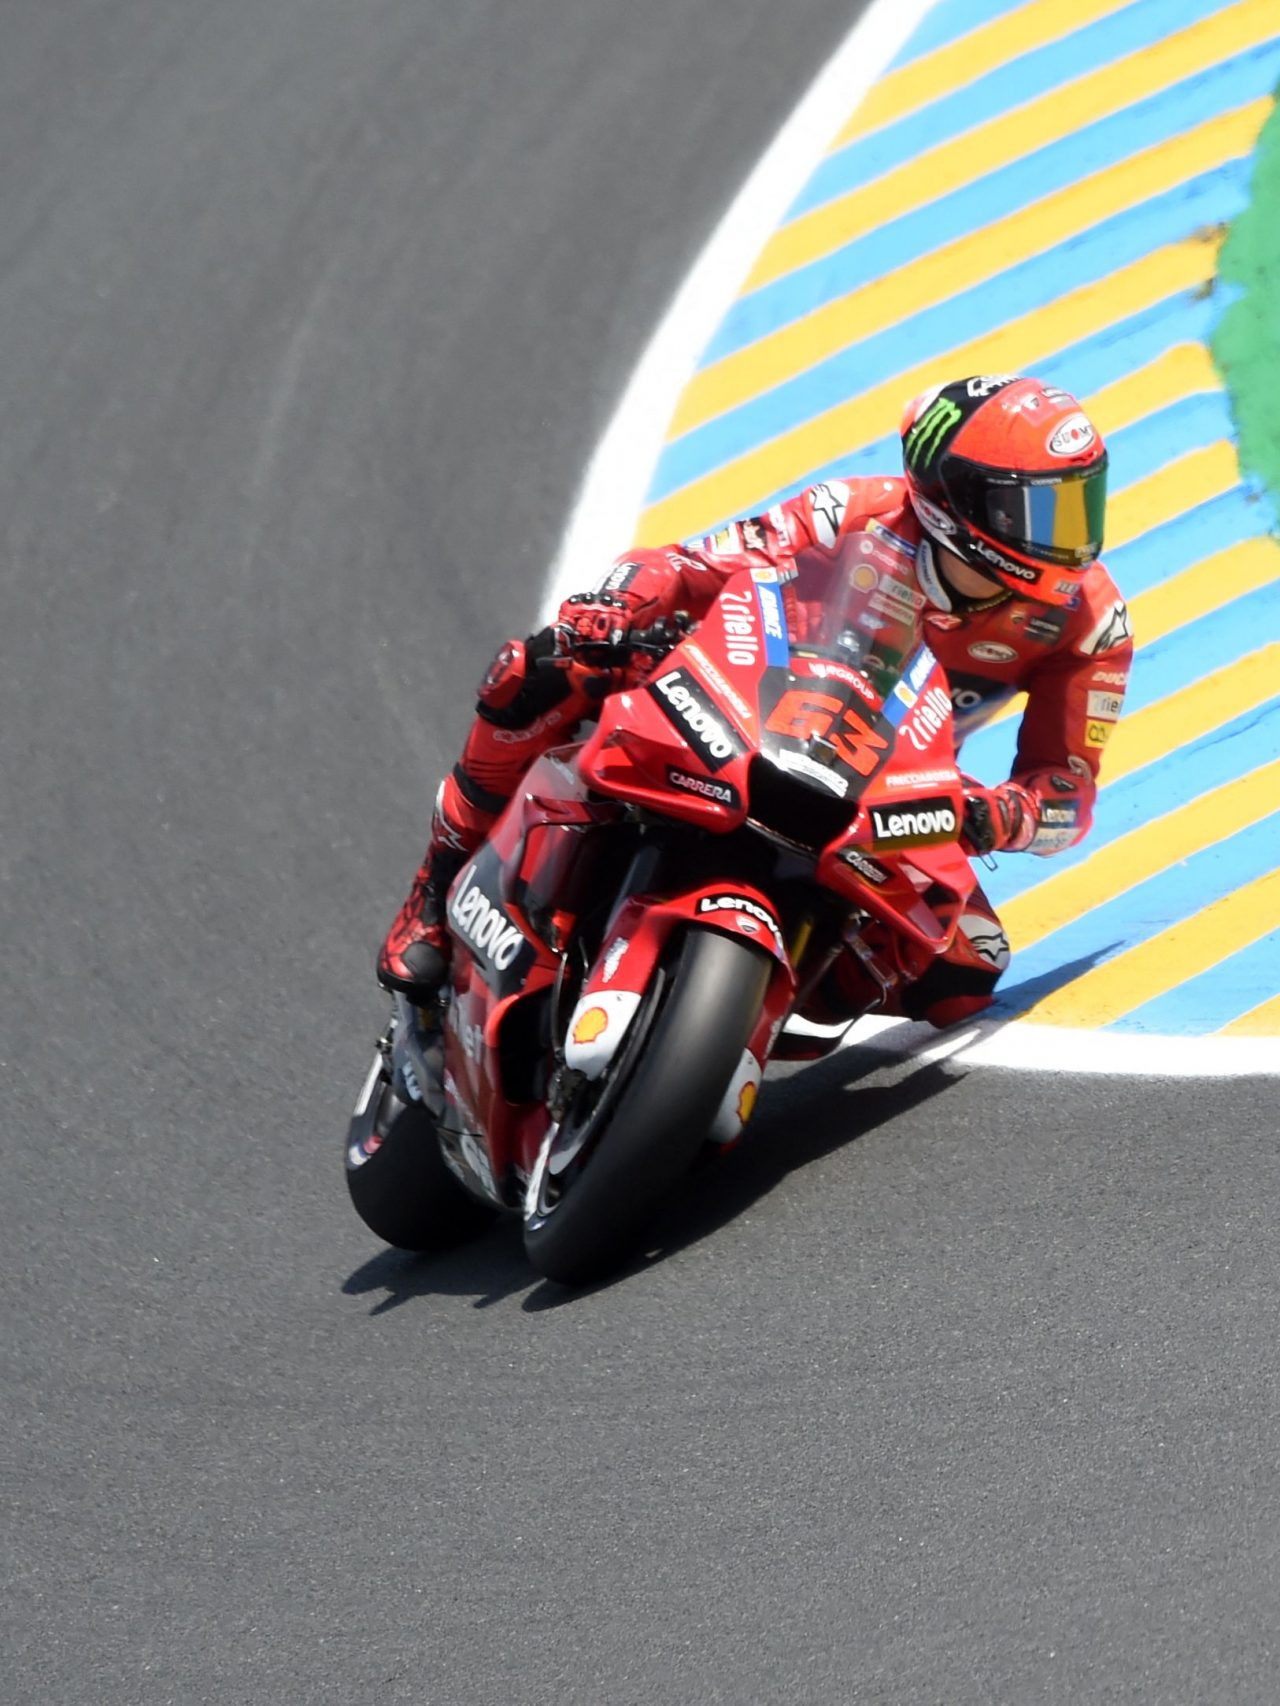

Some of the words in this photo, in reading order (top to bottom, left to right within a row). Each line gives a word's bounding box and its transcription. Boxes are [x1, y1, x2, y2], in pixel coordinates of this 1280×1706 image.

[976, 540, 1037, 581] Lenovo
[655, 671, 733, 759] Lenovo
[669, 771, 733, 804] CARRERA
[872, 808, 957, 839] Lenovo
[452, 864, 525, 971] Lenovo
